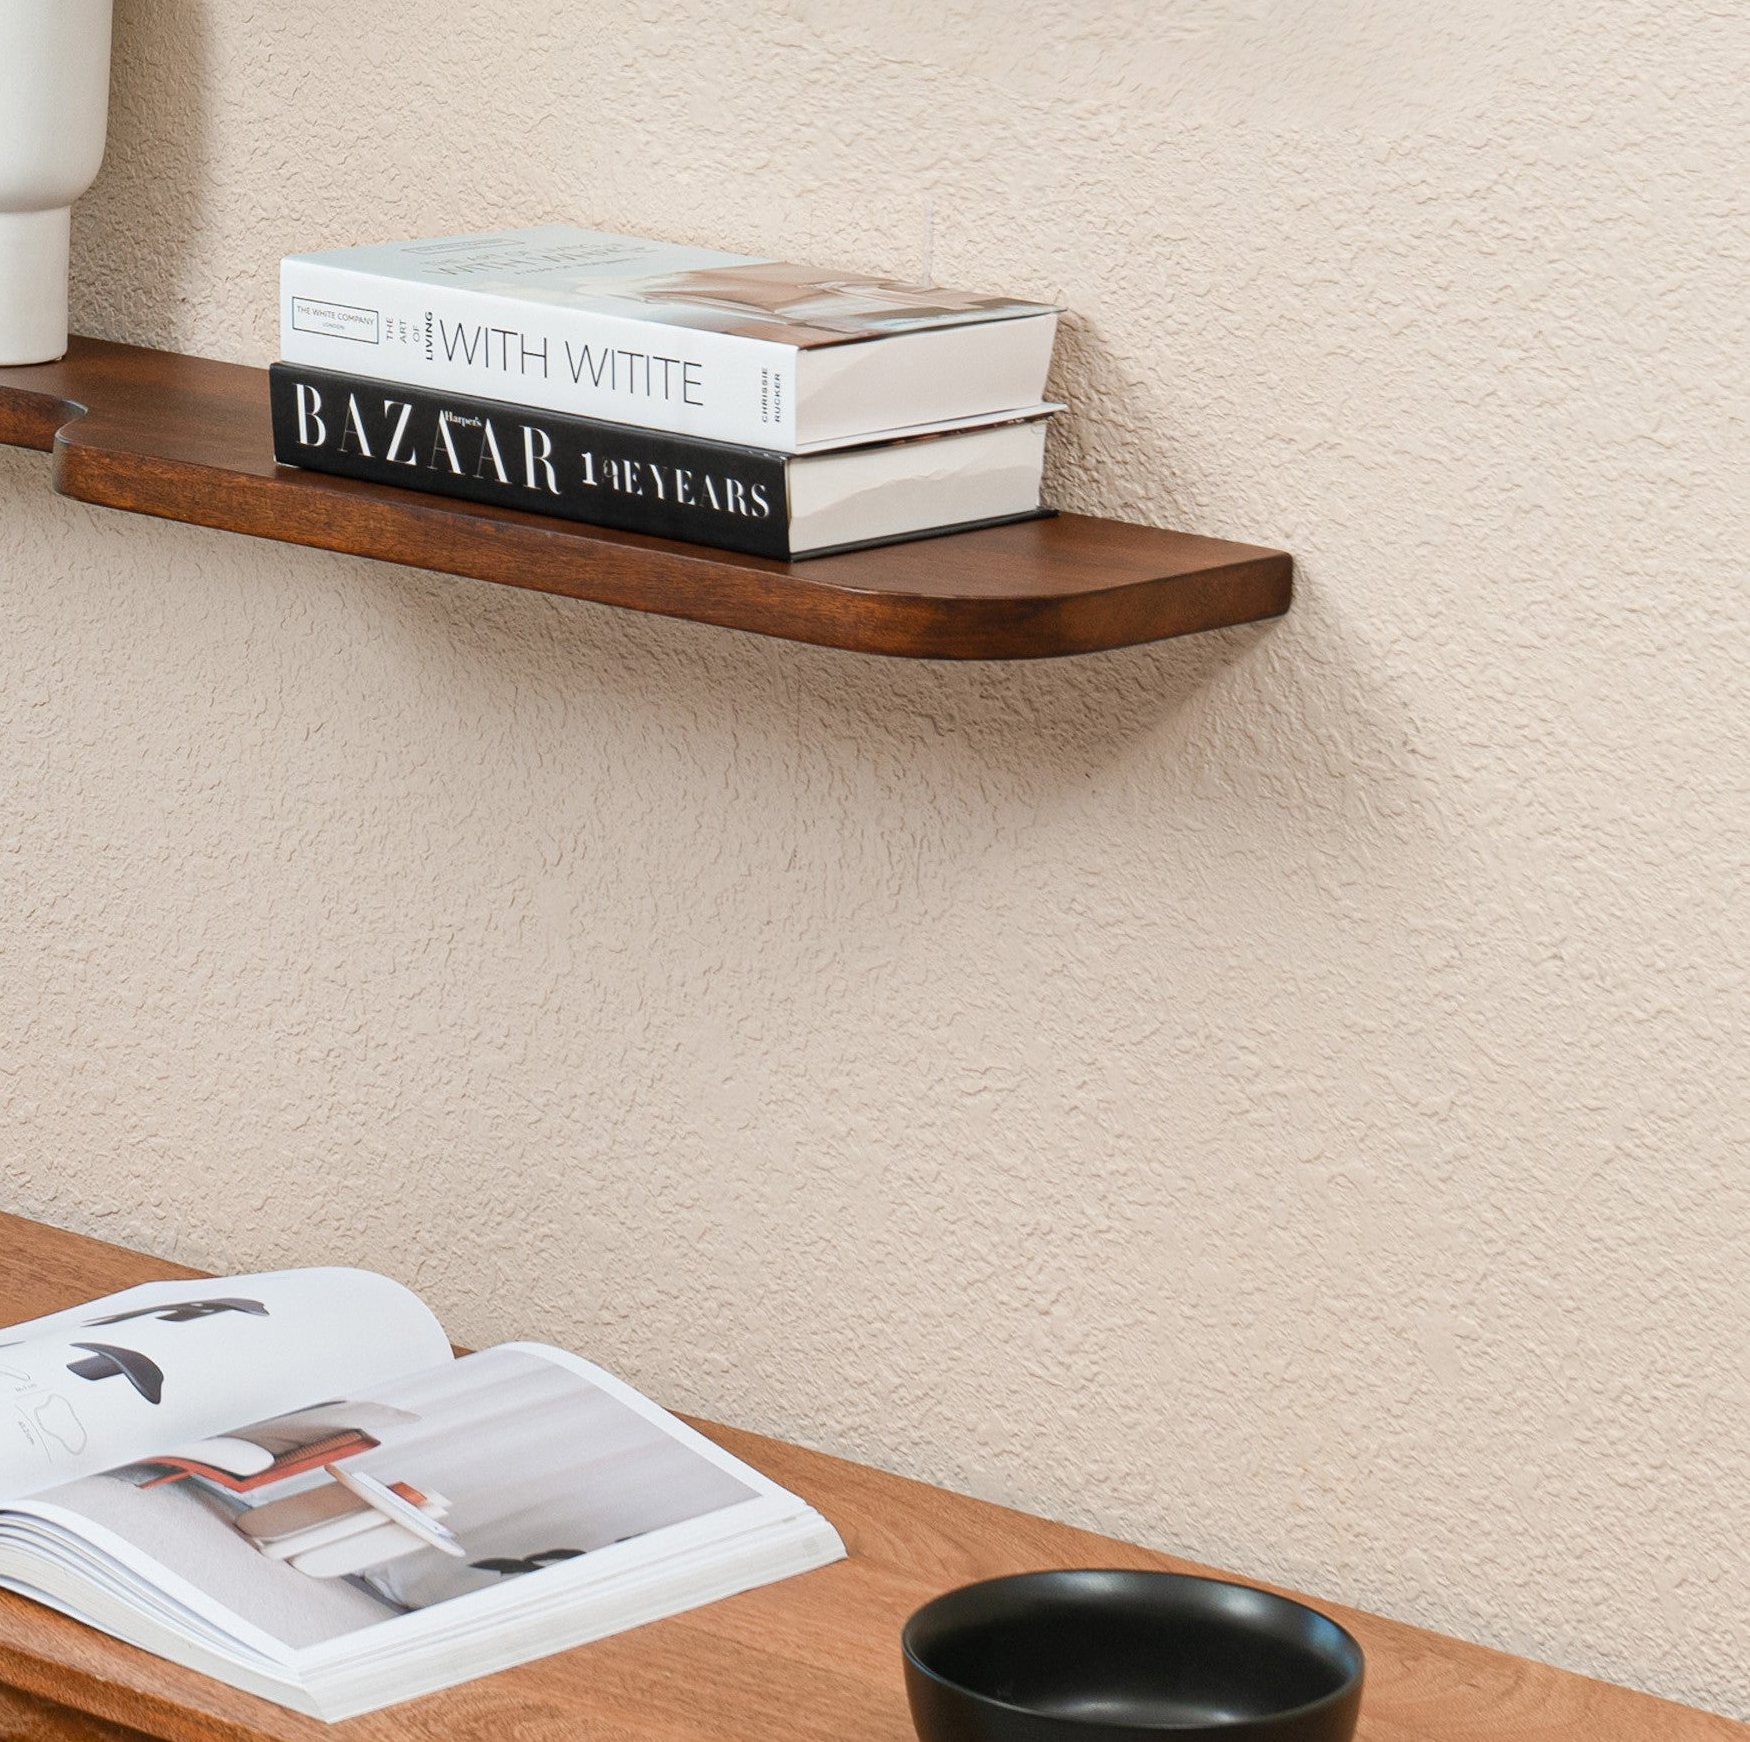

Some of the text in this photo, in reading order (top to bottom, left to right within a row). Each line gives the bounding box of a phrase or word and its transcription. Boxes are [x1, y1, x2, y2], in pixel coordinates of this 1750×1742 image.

[297, 305, 375, 326] THE WHITE COMPANY
[386, 316, 394, 341] THE
[399, 318, 407, 344] ART
[412, 324, 420, 343] OF
[424, 311, 434, 361] LIVING
[439, 318, 548, 378] WITH
[294, 382, 562, 496] BAZAAR
